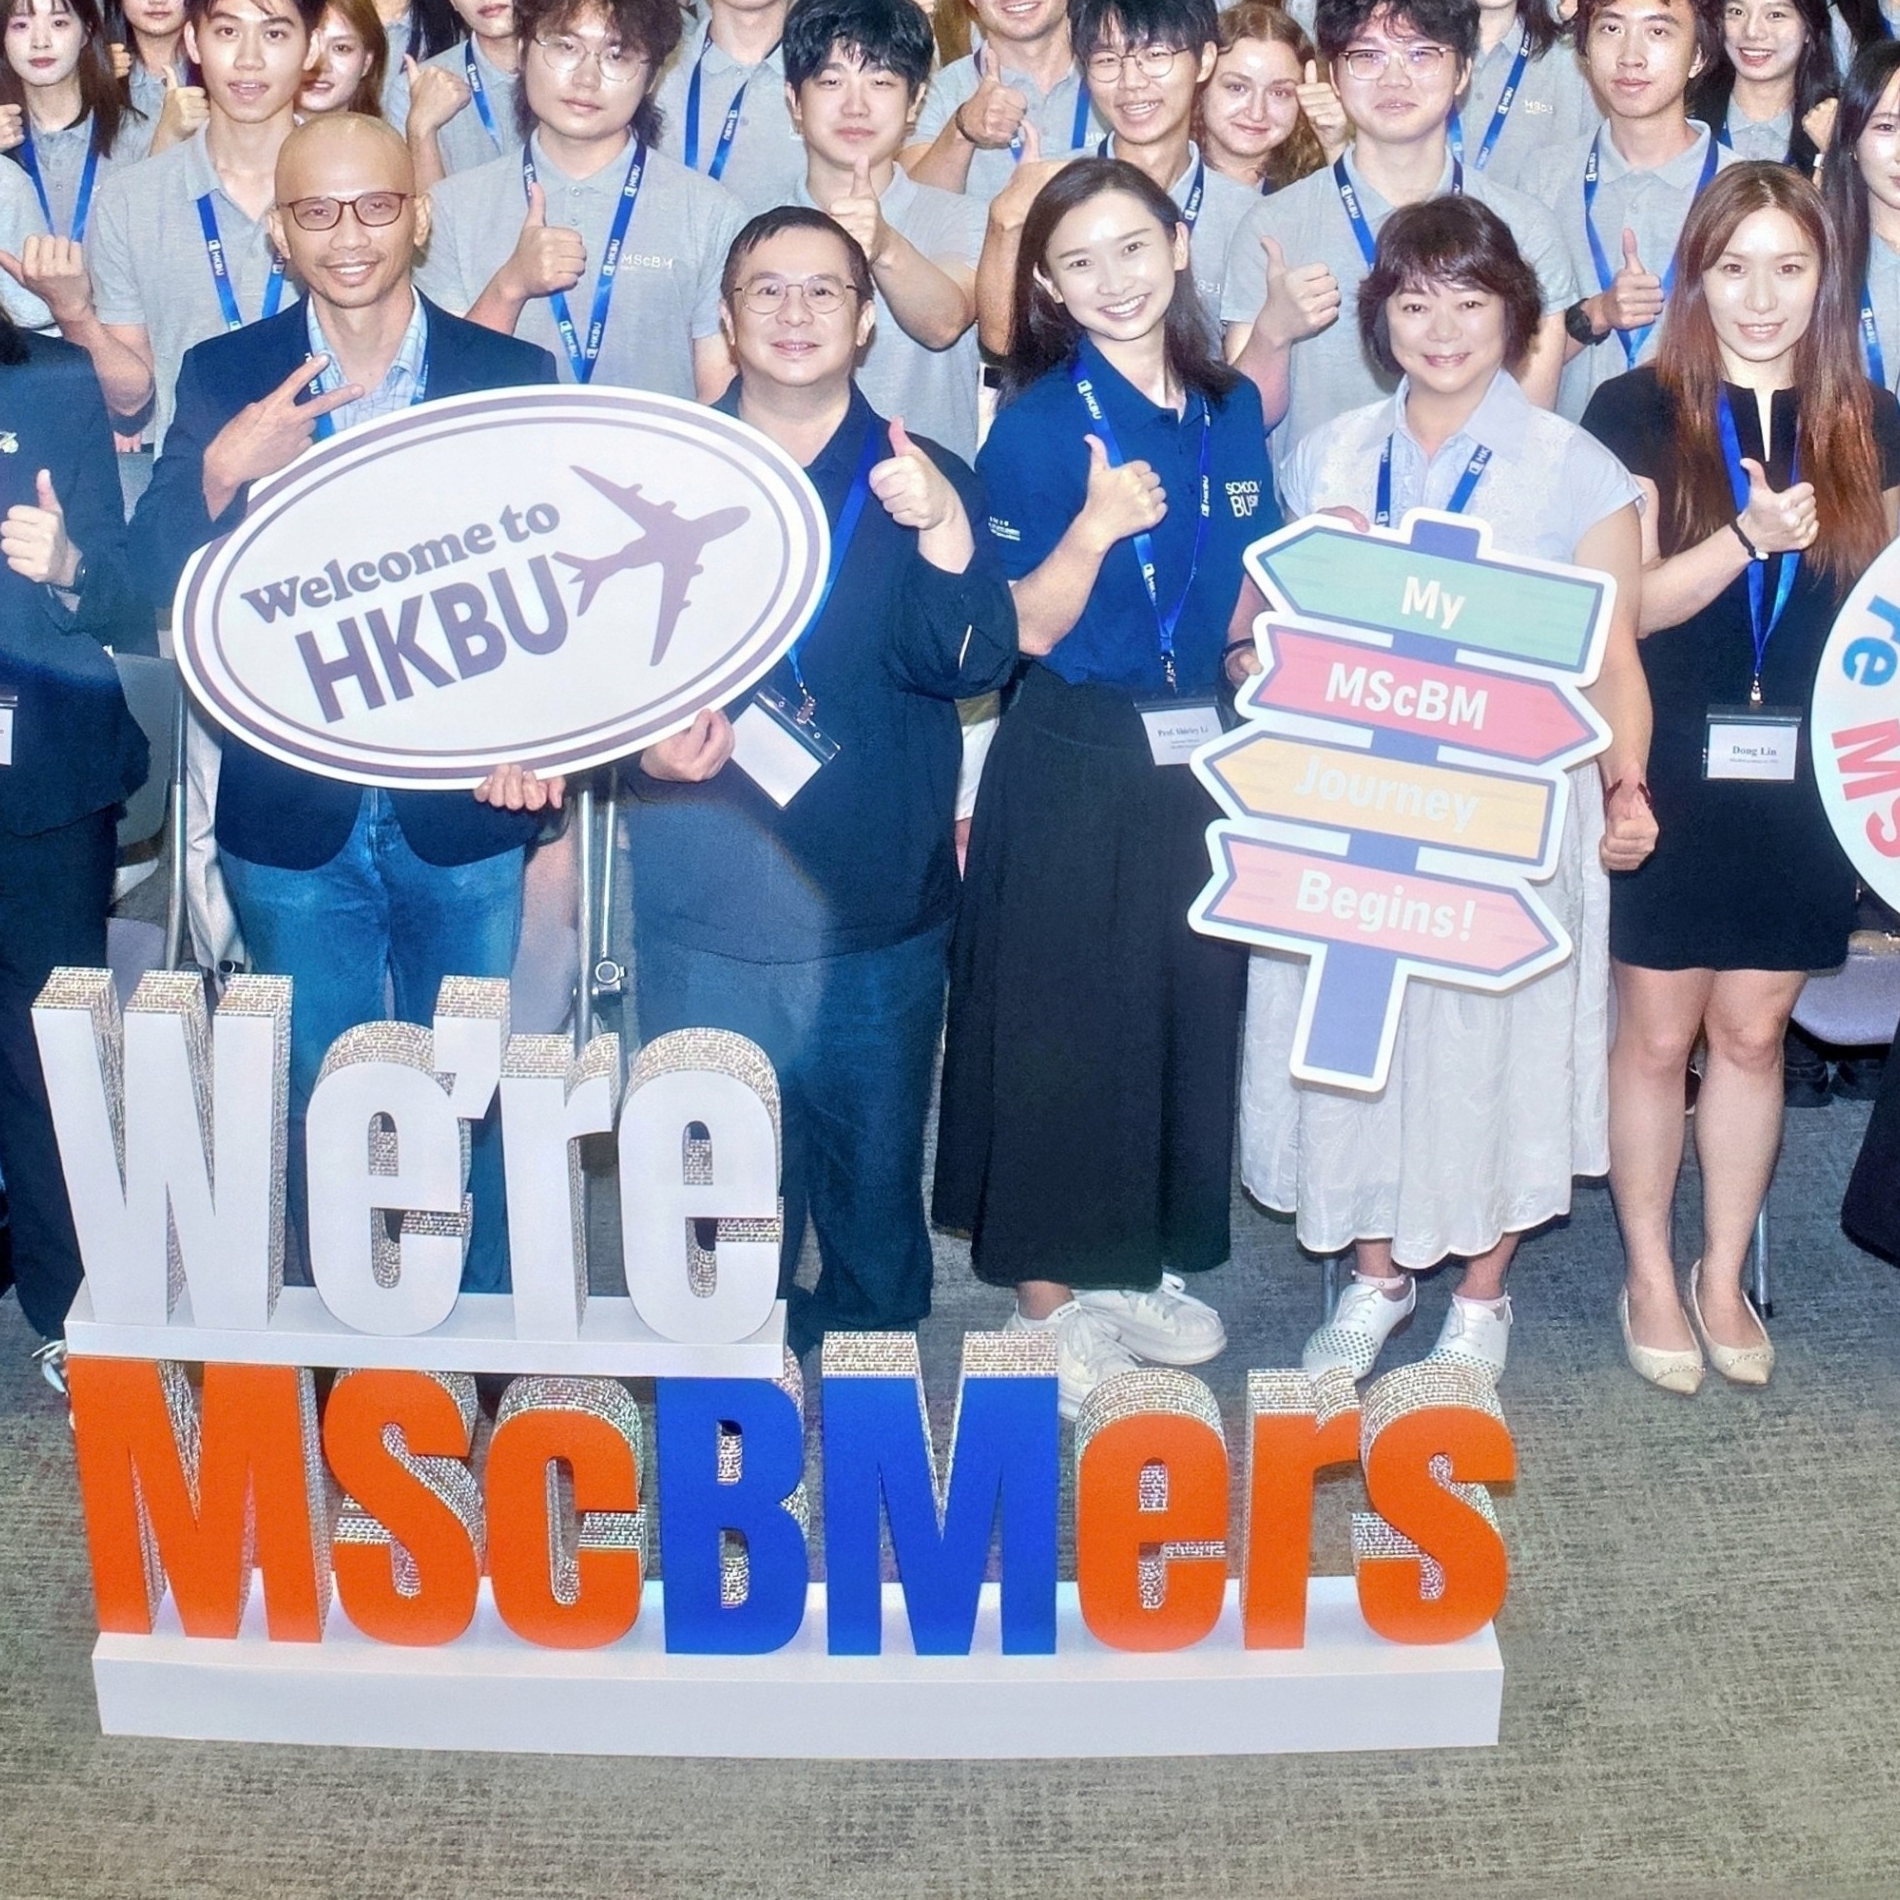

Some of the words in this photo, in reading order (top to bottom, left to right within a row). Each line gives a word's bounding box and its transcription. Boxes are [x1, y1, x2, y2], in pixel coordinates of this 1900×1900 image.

[625, 164, 641, 182] HKBU
[1346, 187, 1361, 219] HKBU
[605, 239, 620, 266] HKBU
[621, 253, 673, 269] MScBM
[565, 329, 579, 358] HKBU
[589, 322, 602, 350] HKBU
[1083, 391, 1102, 420] HKBU
[239, 520, 496, 624] Welcome
[500, 502, 560, 542] to
[1400, 576, 1467, 630] My
[295, 553, 569, 724] HKBU
[1324, 662, 1488, 730] MScBM
[1732, 745, 1758, 756] Dong
[1760, 747, 1777, 755] Lin
[1292, 755, 1482, 833] Journey
[1294, 868, 1476, 942] Begins!
[32, 966, 786, 1342] We're
[68, 1330, 1516, 1656] MScBMers
